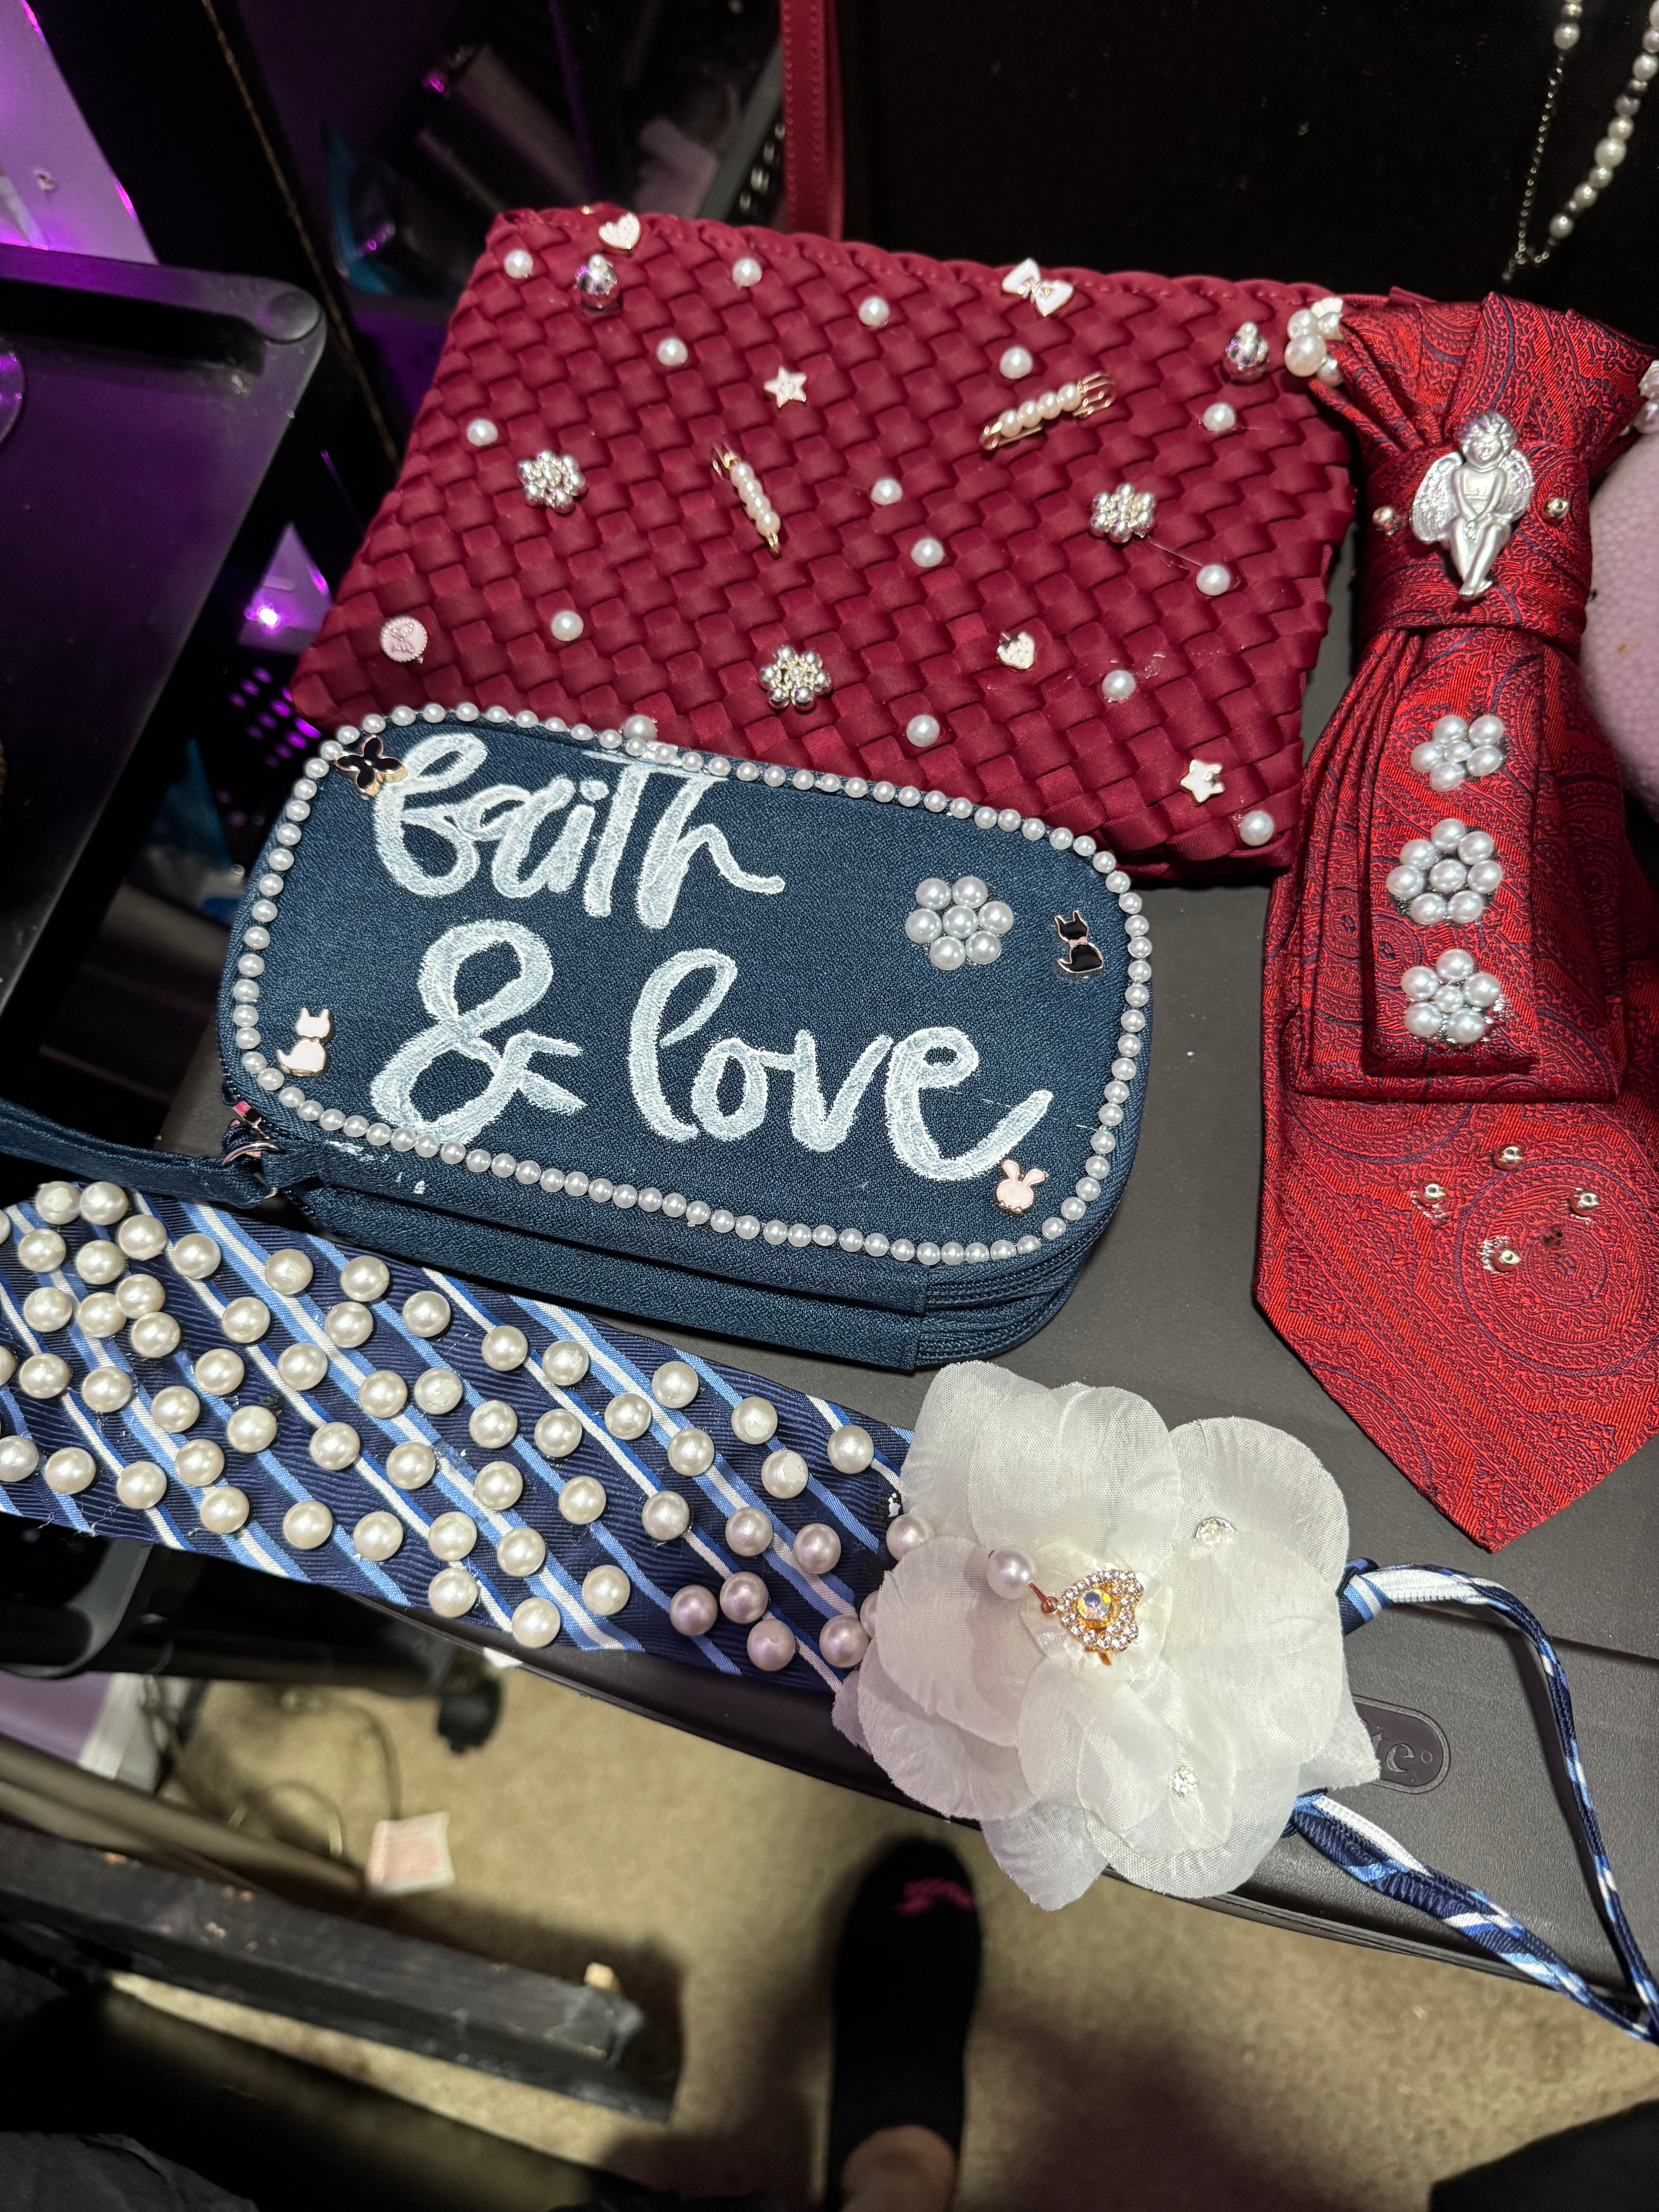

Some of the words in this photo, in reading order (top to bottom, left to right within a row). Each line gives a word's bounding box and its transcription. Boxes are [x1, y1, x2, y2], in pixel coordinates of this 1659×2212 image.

[374, 732, 785, 930] faith
[370, 919, 588, 1144] &
[628, 949, 1053, 1181] love
